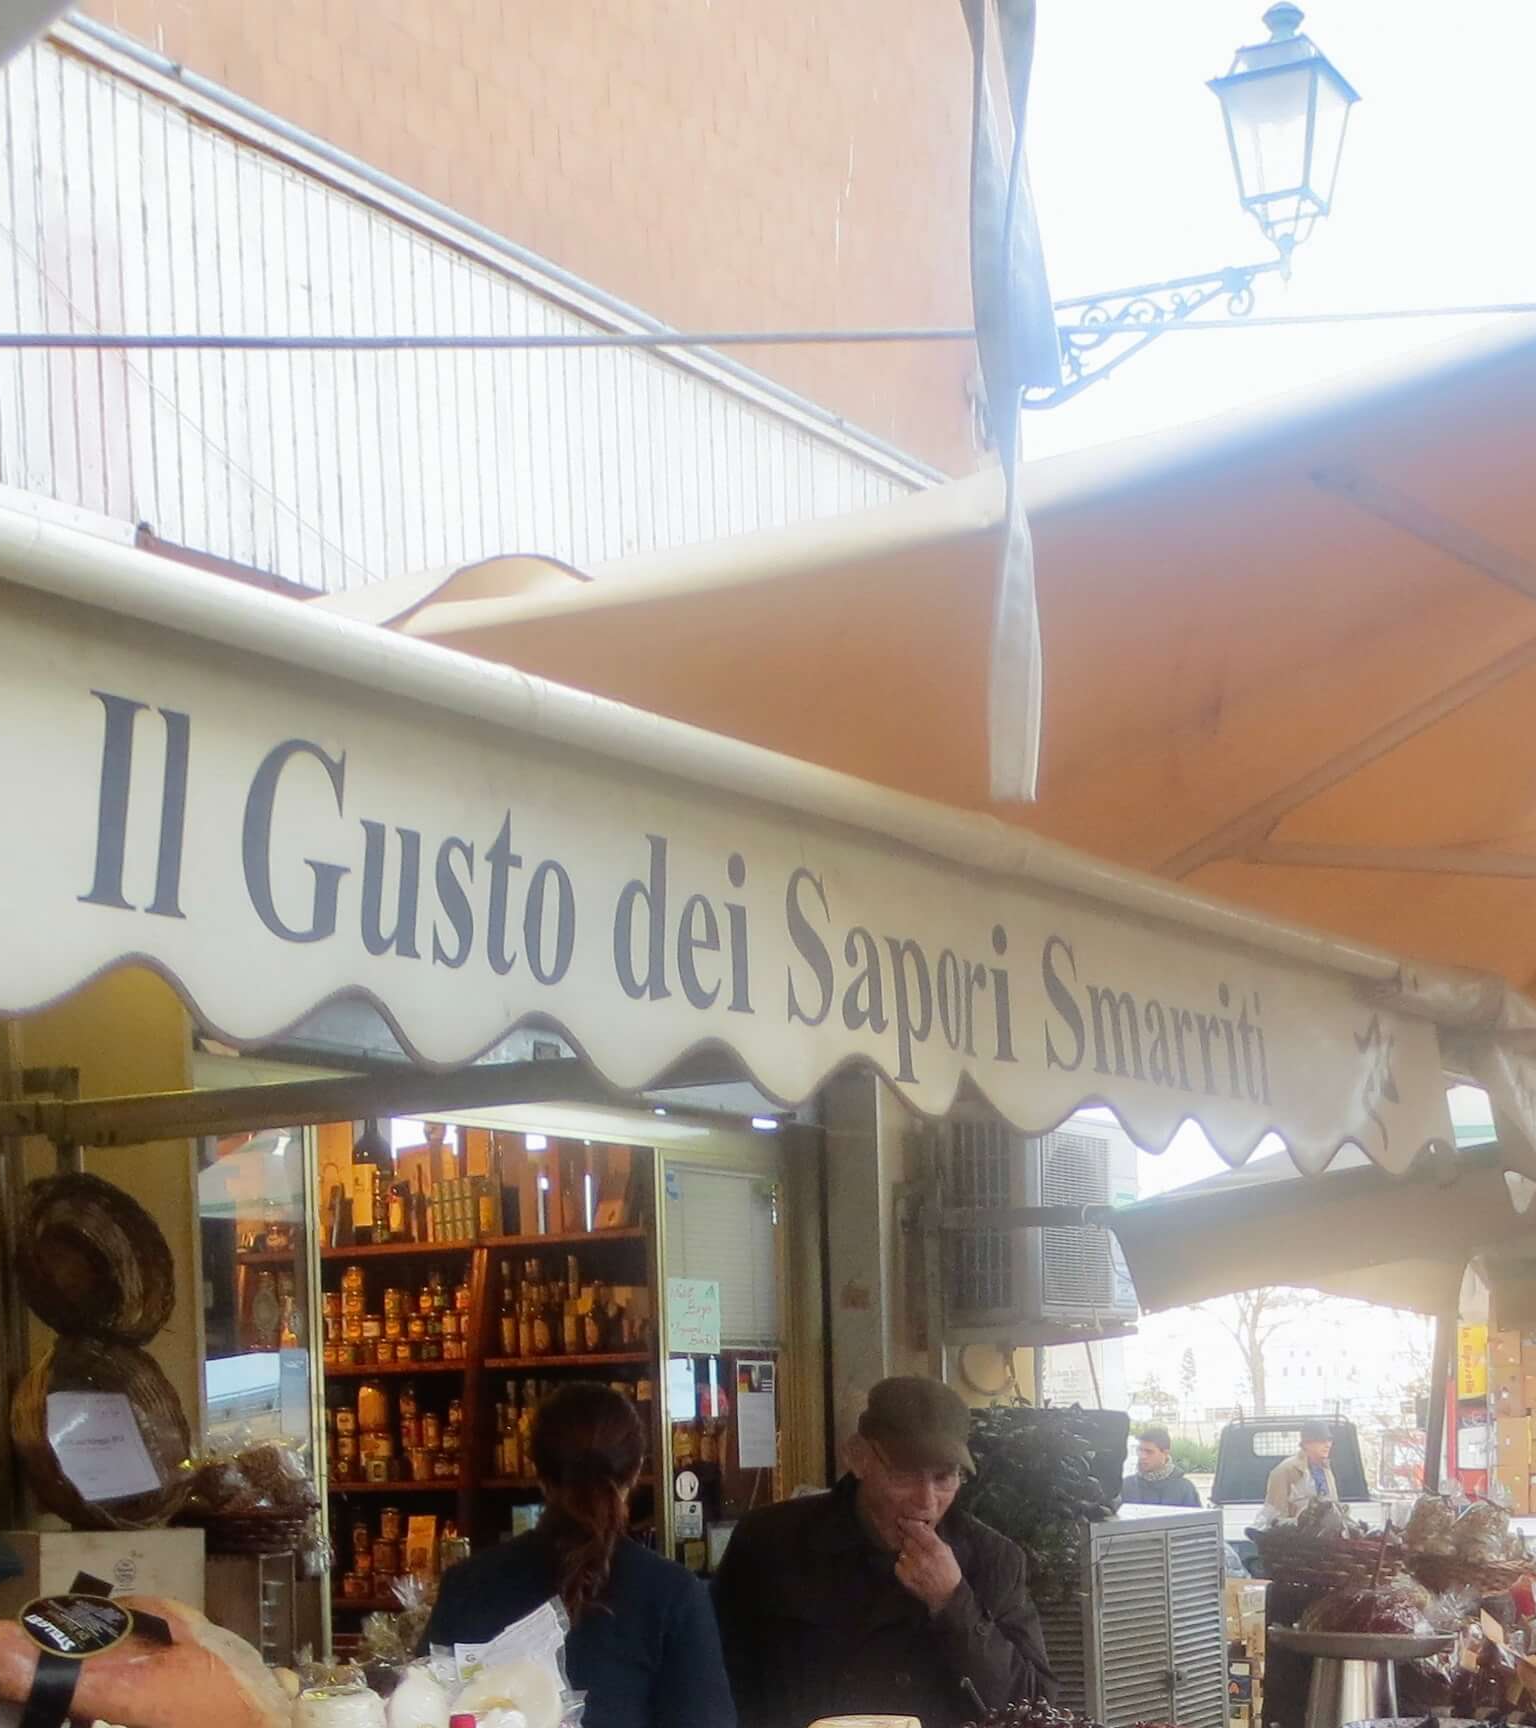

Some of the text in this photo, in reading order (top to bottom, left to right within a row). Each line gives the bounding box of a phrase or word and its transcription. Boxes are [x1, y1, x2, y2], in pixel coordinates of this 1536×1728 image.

[76, 689, 1270, 1105] Il Gusto dei Sapori Smarriti
